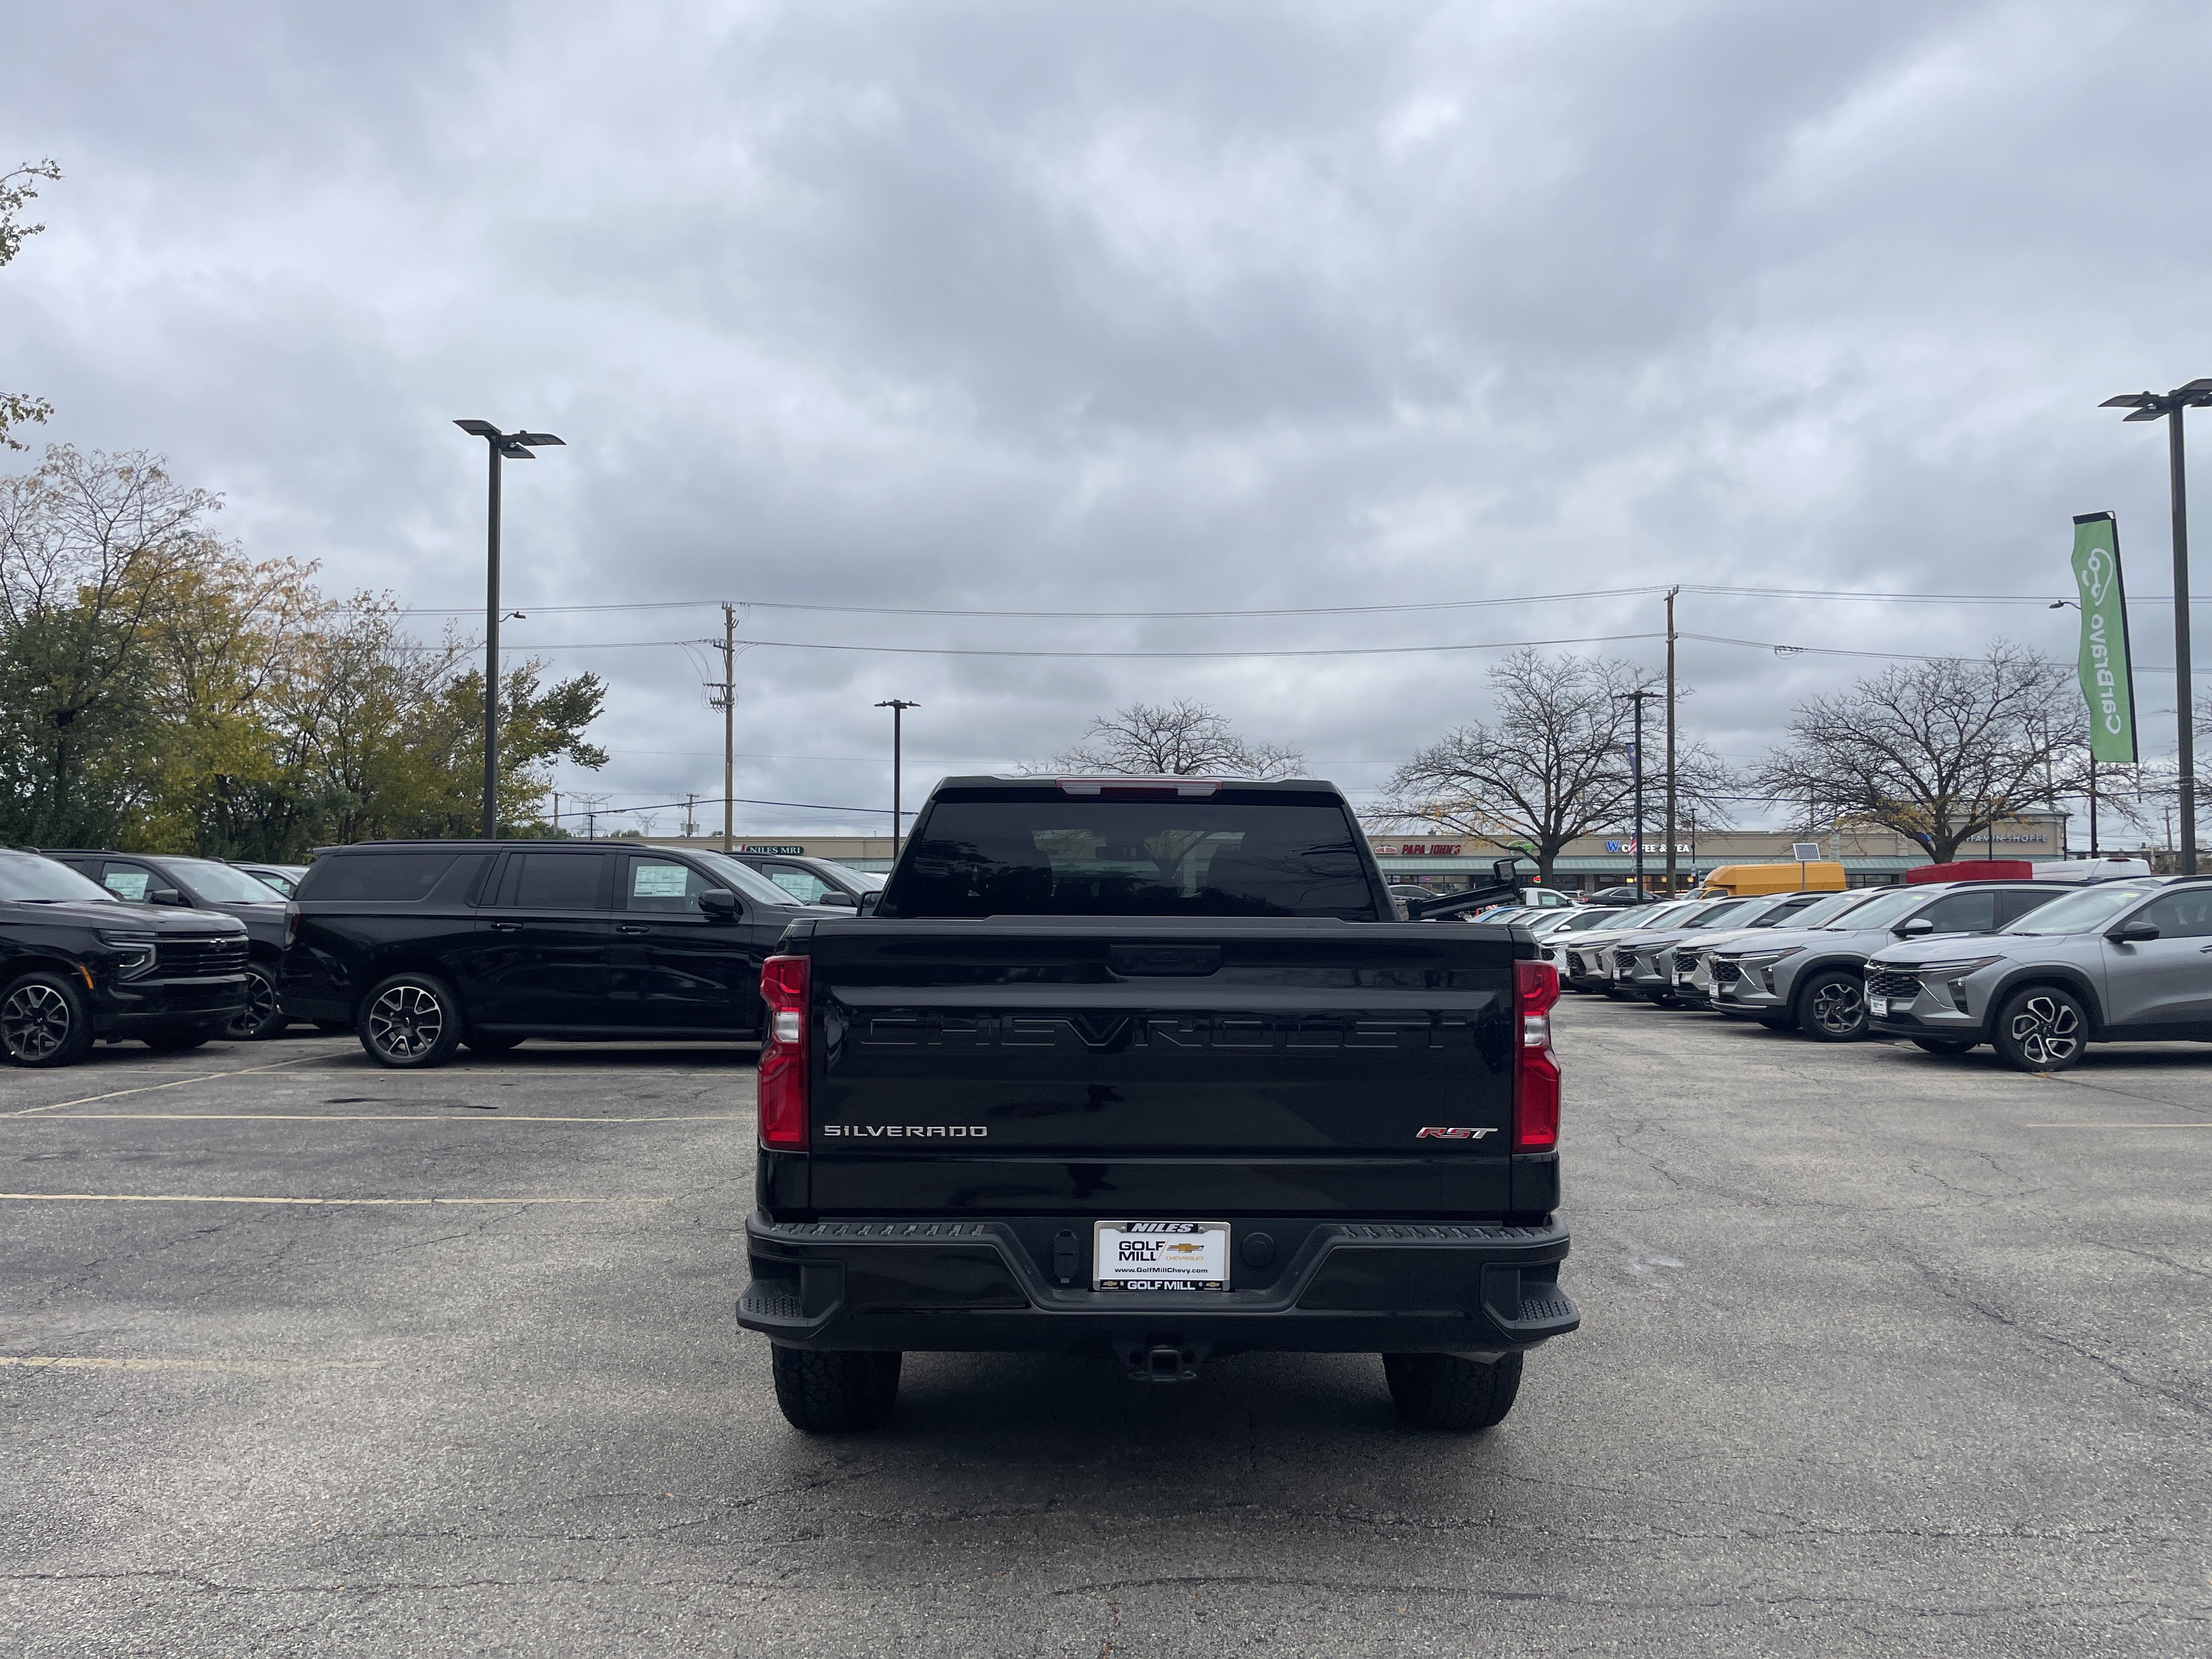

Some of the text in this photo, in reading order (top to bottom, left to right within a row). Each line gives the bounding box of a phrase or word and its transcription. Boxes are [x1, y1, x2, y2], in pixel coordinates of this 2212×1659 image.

[2090, 613, 2121, 735] CarBravo
[1401, 844, 1425, 855] PAPA
[1674, 844, 1690, 853] EA
[860, 1013, 1468, 1048] CHEVROLET
[824, 1125, 988, 1137] SILVERADO
[1415, 1127, 1498, 1139] RST
[1131, 1223, 1194, 1233] NILES
[1119, 1241, 1166, 1251] GOLF
[1119, 1251, 1156, 1261] MILL
[1127, 1281, 1195, 1290] GOLF MILL
